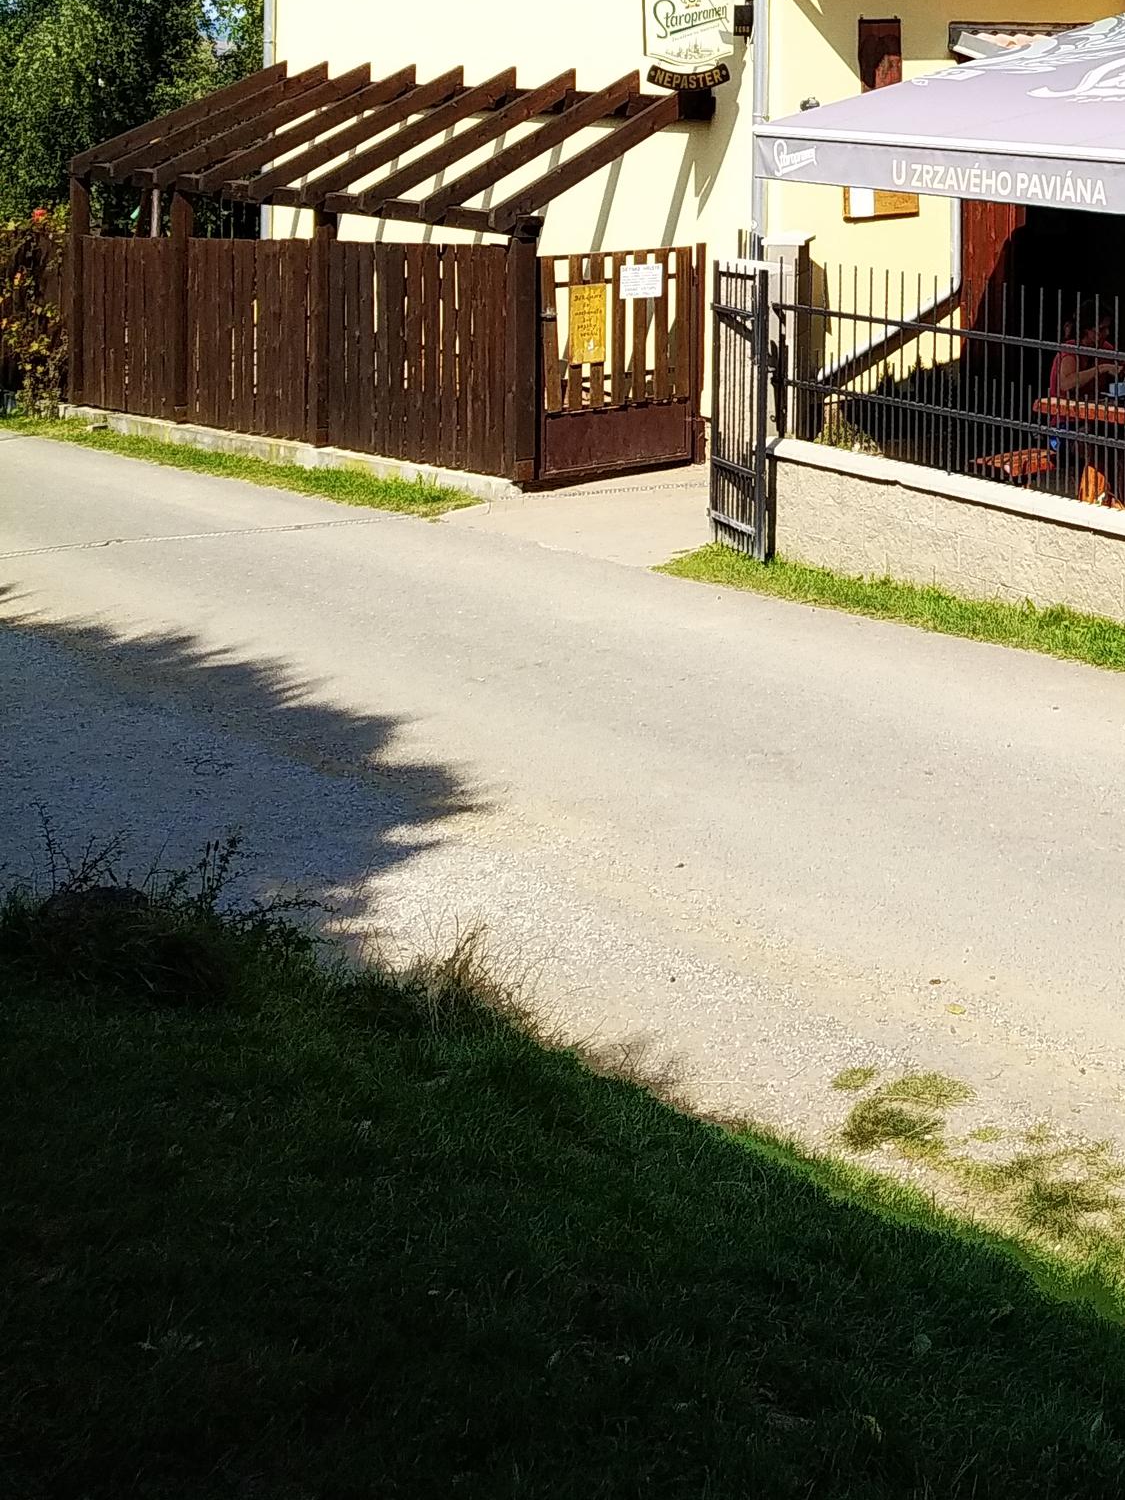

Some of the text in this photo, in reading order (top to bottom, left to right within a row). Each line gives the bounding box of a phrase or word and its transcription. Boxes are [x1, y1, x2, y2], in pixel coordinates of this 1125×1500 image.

[653, 0, 730, 39] Staropramen
[654, 68, 723, 89] NEPASTER
[892, 159, 1108, 206] U ZRZAVÉHO PAVIÁNA
